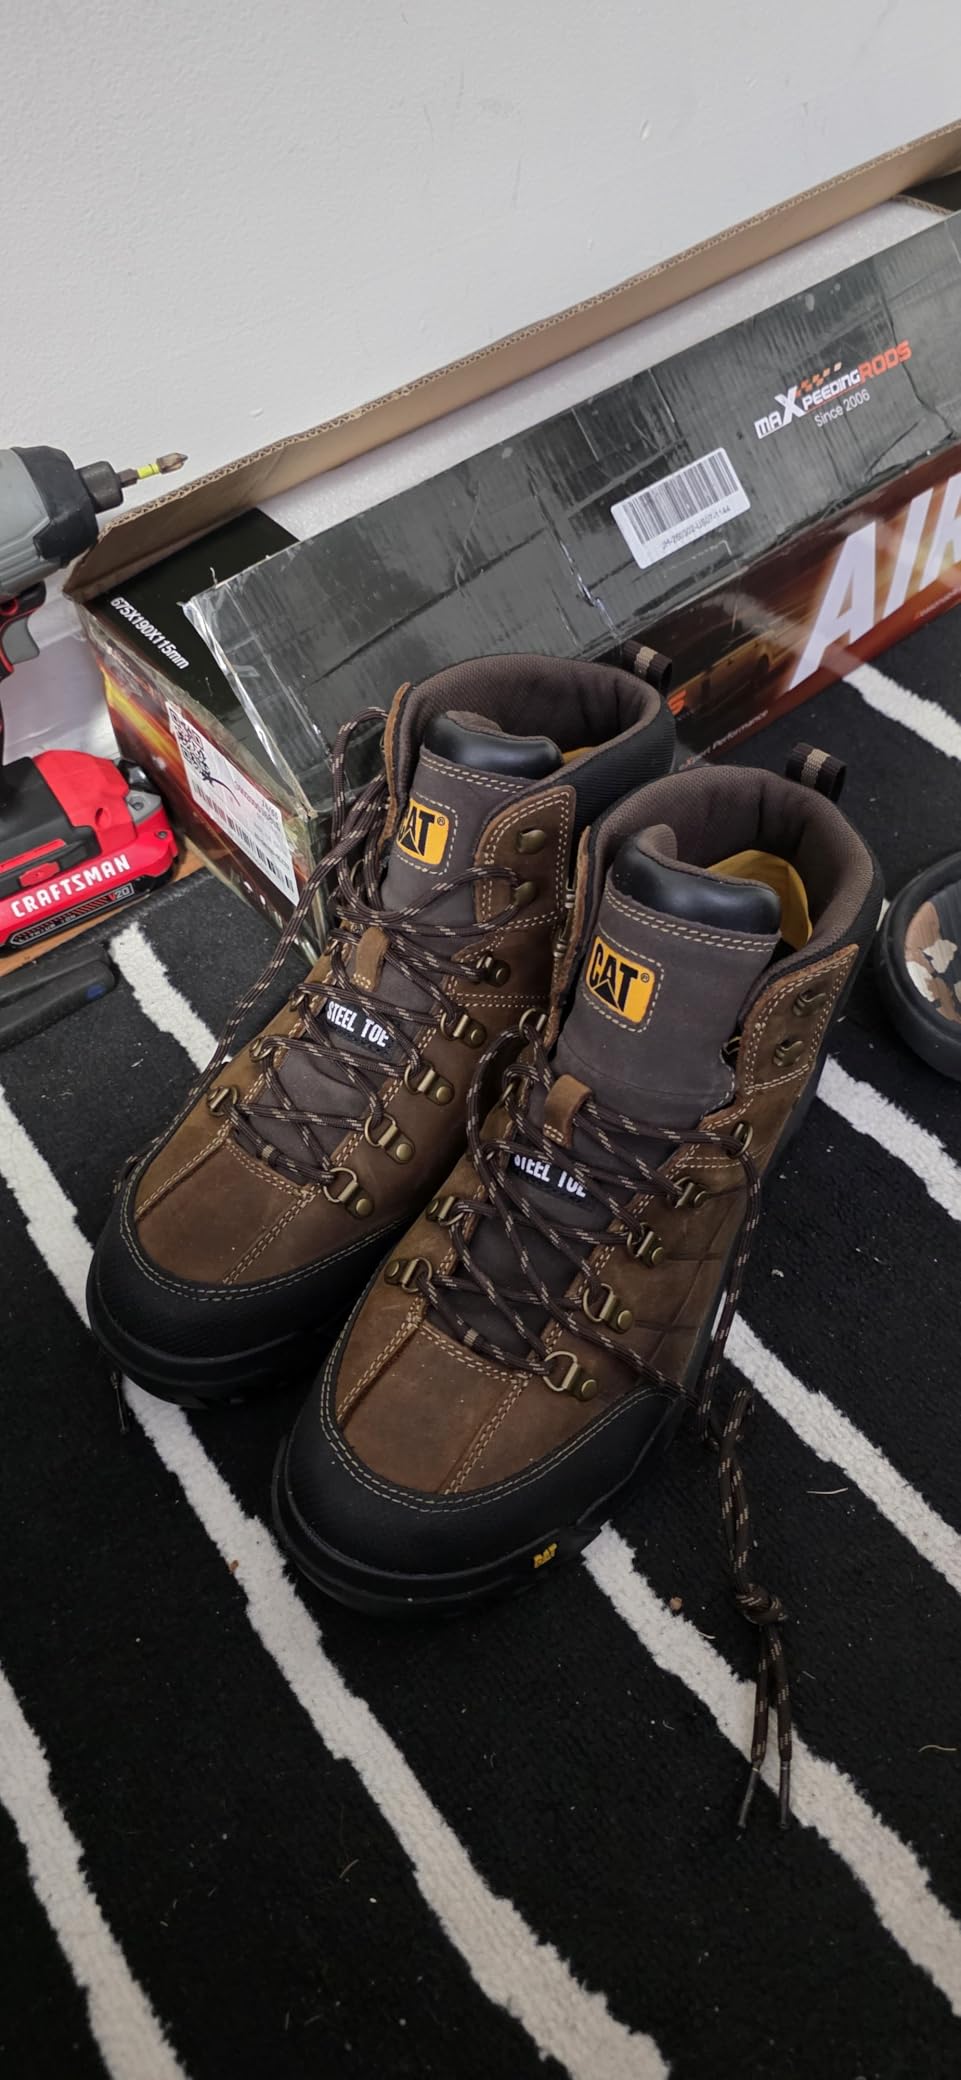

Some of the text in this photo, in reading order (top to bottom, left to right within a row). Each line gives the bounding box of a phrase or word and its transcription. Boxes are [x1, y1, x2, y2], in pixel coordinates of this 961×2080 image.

[814, 388, 871, 428] Since 2006
[400, 805, 436, 857] AT
[11, 853, 131, 918] CRAFTSMAN
[107, 887, 131, 901] V20
[326, 1001, 390, 1048] STEEL TOE
